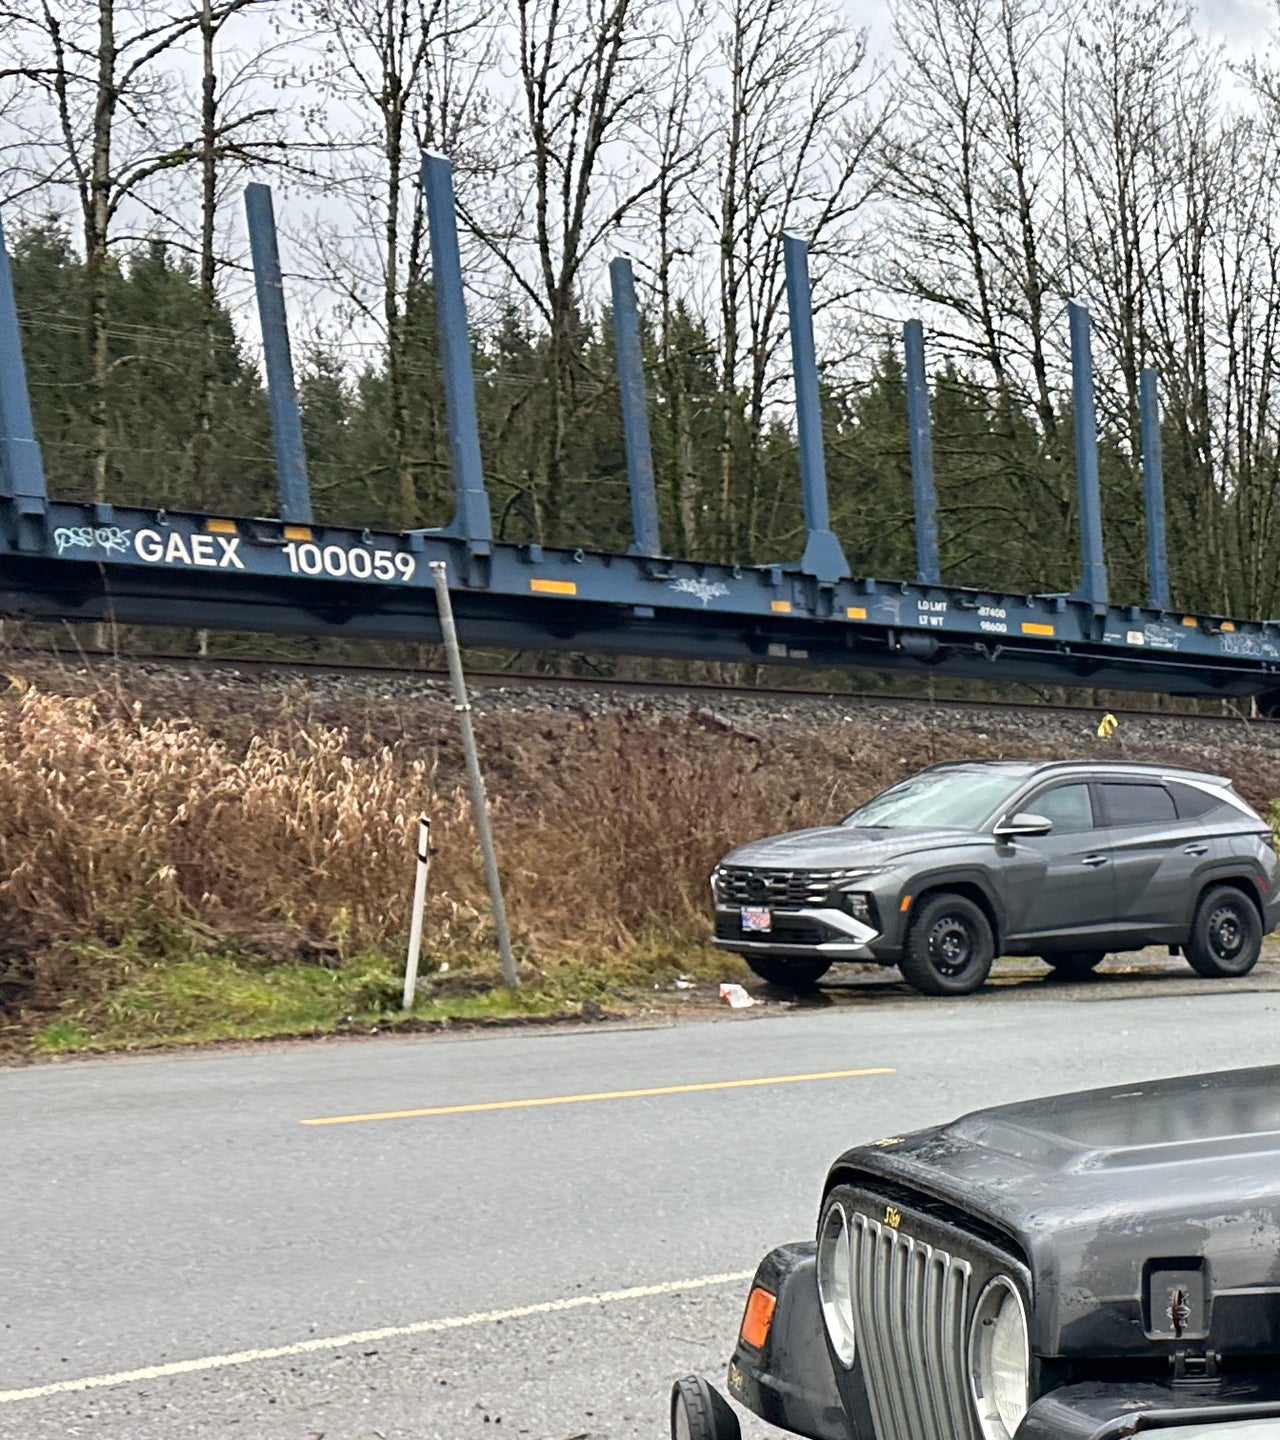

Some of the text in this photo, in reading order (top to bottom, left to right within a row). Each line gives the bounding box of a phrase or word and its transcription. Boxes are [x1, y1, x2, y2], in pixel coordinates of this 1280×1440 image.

[134, 529, 245, 569] GAEX
[282, 544, 416, 581] 100059
[930, 616, 945, 627] WT
